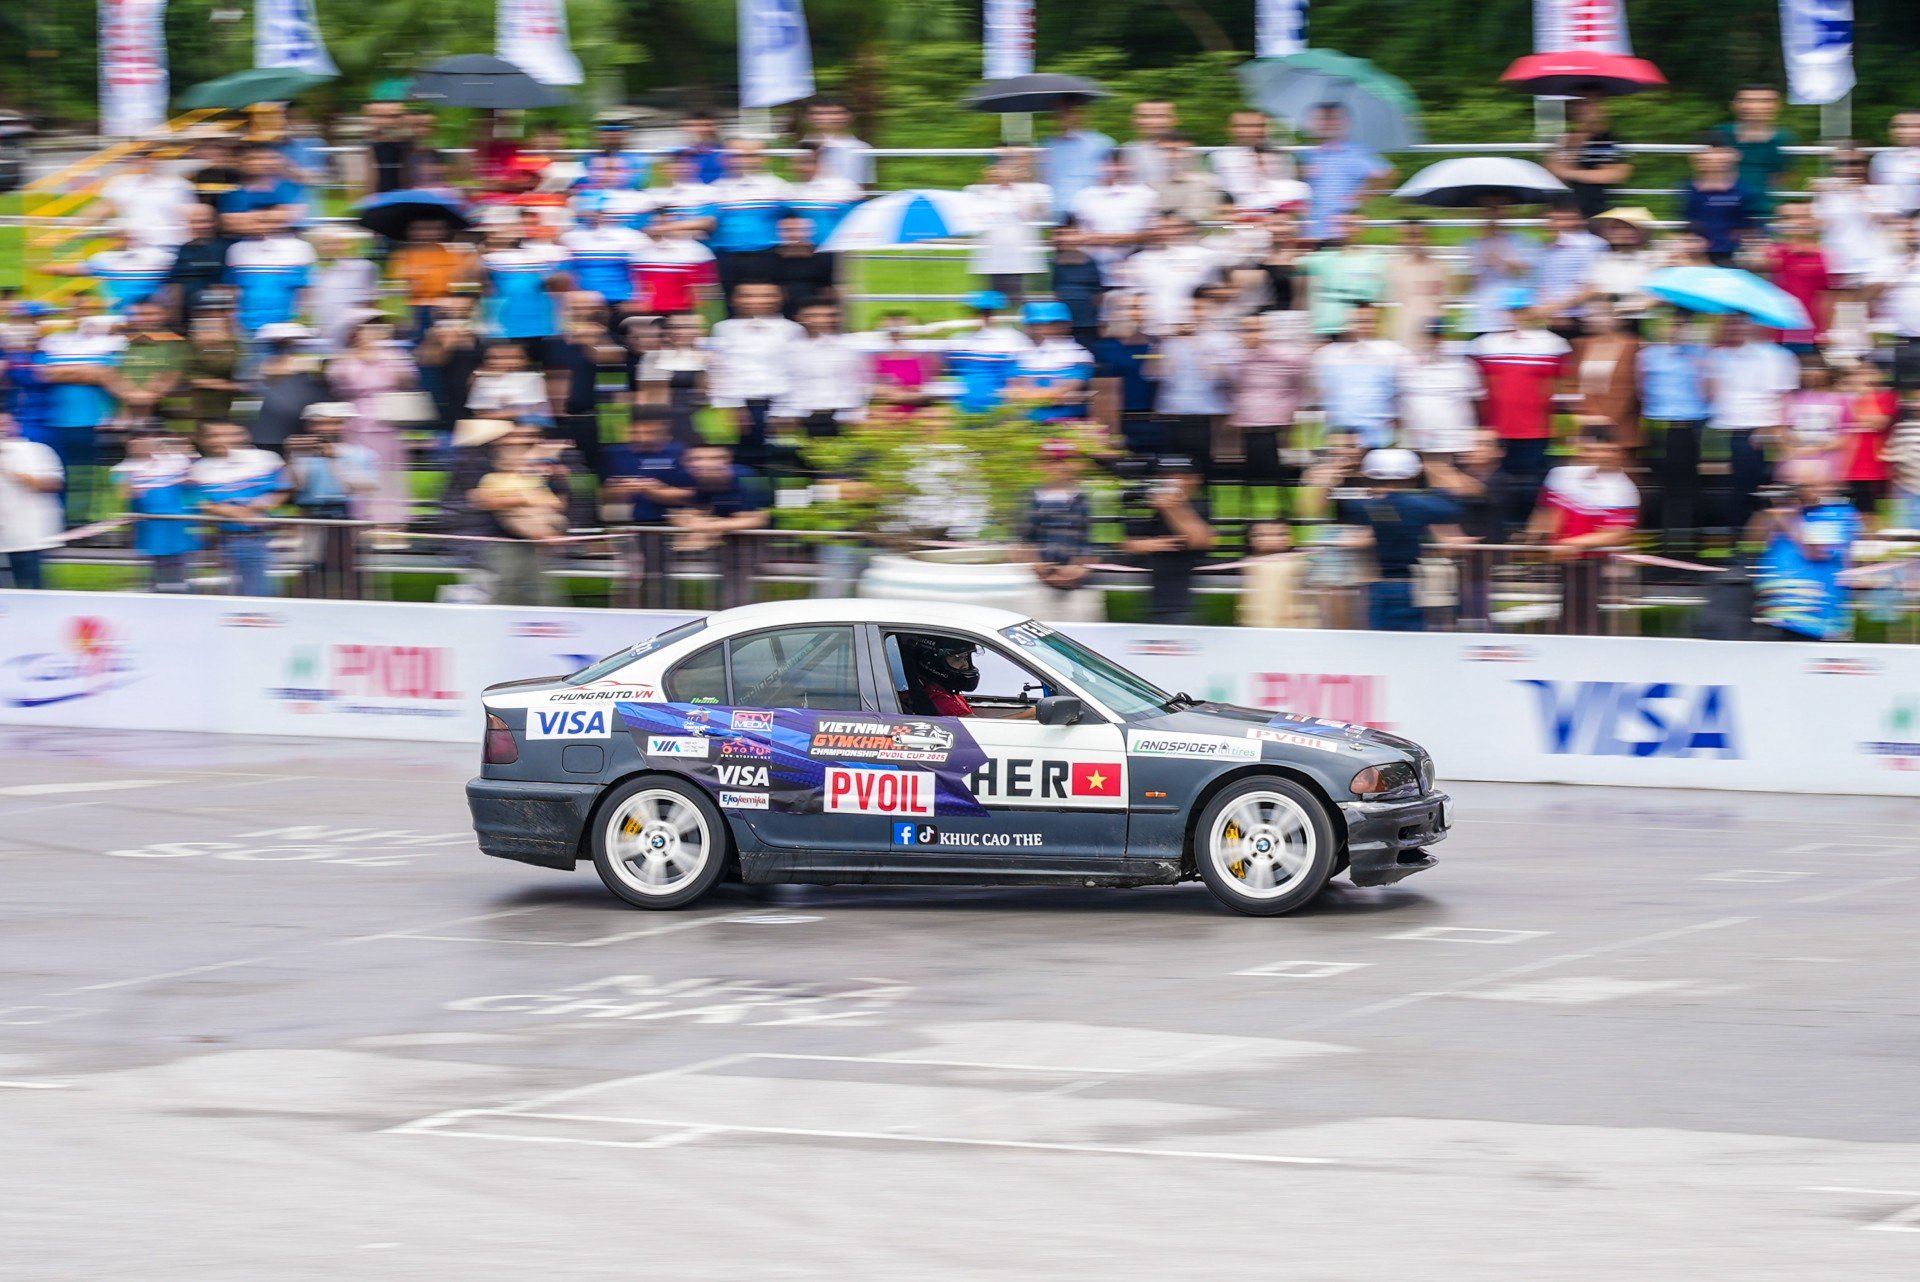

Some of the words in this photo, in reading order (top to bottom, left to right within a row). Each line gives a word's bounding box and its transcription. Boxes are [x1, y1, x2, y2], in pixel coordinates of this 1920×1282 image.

[534, 711, 605, 735] VISA
[1513, 679, 1744, 759] VISA
[818, 721, 890, 735] VIETNAM
[812, 734, 909, 751] GYMKHAN
[1256, 730, 1326, 748] PVOIL
[810, 748, 878, 758] CHAMPIONSHIP
[880, 752, 905, 760] PVOIL
[1133, 740, 1217, 754] LANDSPIDER
[1231, 747, 1256, 757] tires
[712, 765, 770, 787] VISA
[831, 771, 928, 812] PVOIL
[940, 832, 980, 846] KHUC
[982, 833, 1010, 846] CAO
[1013, 834, 1043, 846] THE
